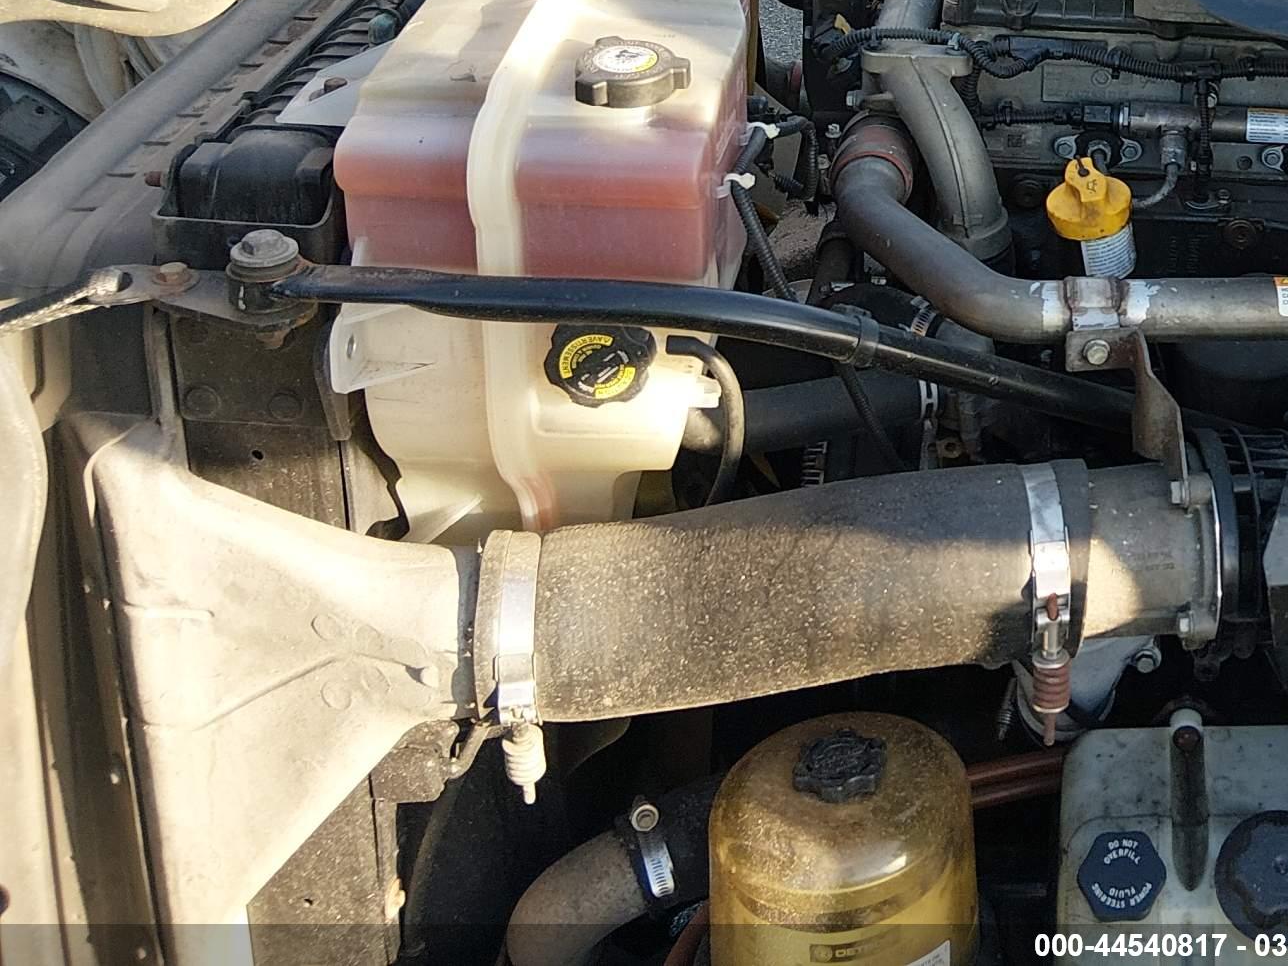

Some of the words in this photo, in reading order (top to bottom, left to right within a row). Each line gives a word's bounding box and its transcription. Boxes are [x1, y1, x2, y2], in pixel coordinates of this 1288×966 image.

[561, 335, 603, 376] AVERTISSEMENT
[1108, 840, 1119, 850] DO
[1122, 838, 1139, 848] NOT
[1103, 849, 1141, 865] OVERFILL
[1091, 882, 1126, 909] STEERING
[1109, 885, 1136, 899] FLUID
[1130, 882, 1153, 907] POWER
